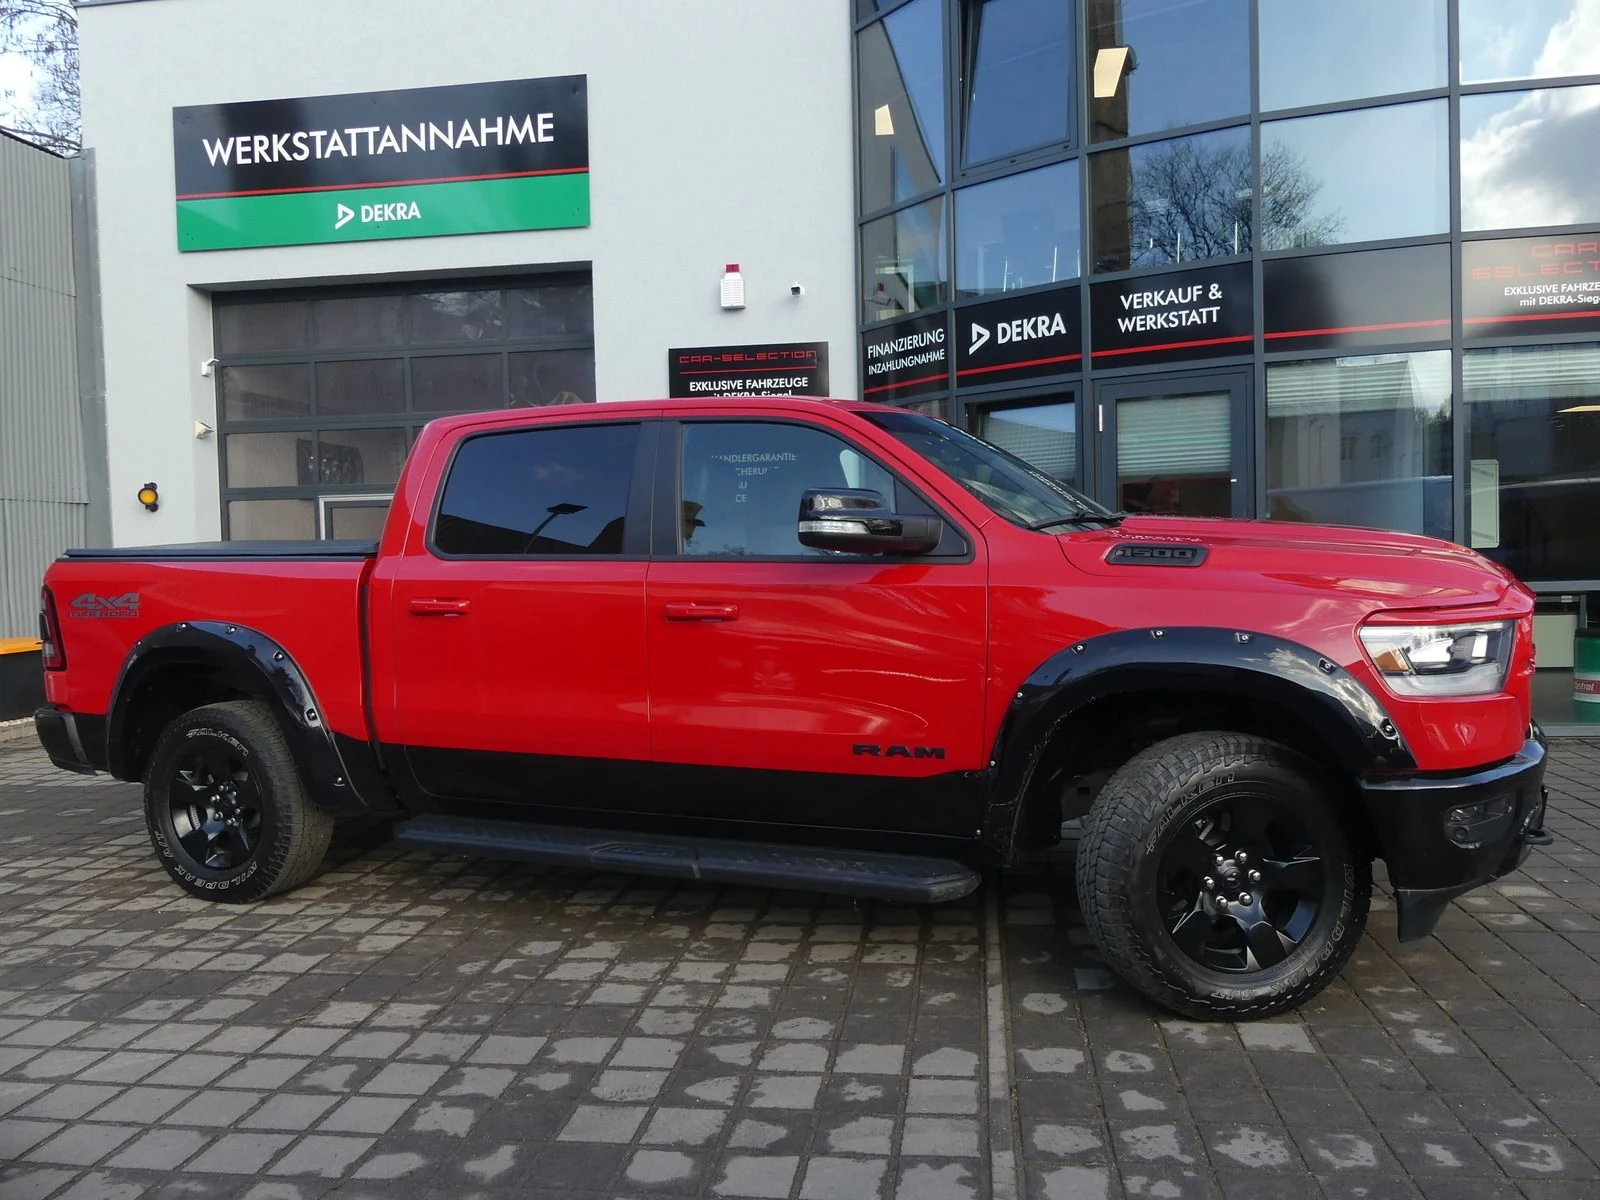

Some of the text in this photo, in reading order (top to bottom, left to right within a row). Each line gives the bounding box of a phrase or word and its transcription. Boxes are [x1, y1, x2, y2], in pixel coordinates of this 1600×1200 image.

[202, 112, 555, 167] WERKSTATTANNAHME
[361, 201, 422, 223] DEKRA
[1120, 283, 1223, 311] VERKAUF &
[1504, 281, 1600, 296] EXKLUSIVE FAHRZE
[1519, 294, 1600, 306] mit DEKRA-Sieg
[997, 312, 1067, 345] DEKRA
[1117, 306, 1221, 333] WERKSTATT
[867, 328, 945, 359] FINANZIERUNG
[868, 349, 945, 376] INZAHLUNGNAHME
[689, 377, 809, 392] EXKLUSIVE FAHRZEUGE
[1115, 547, 1195, 559] 1500
[852, 743, 946, 761] RAM
